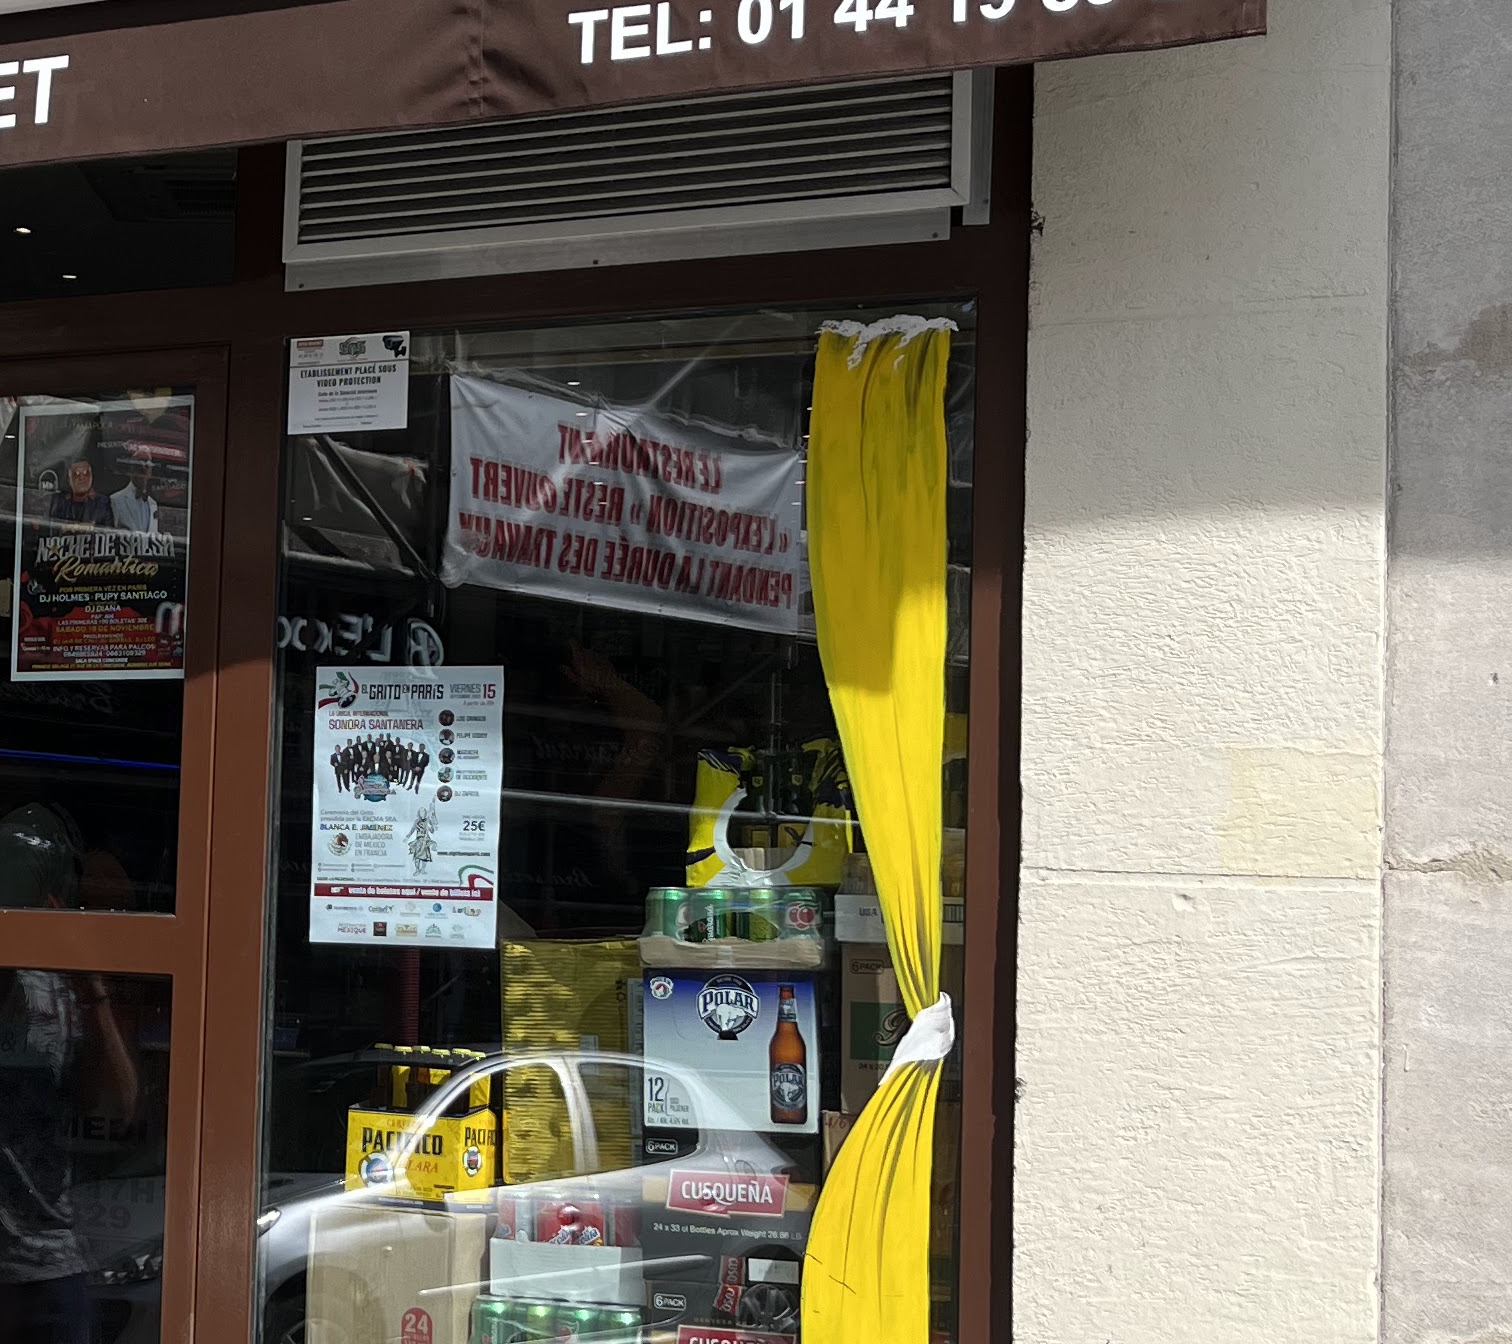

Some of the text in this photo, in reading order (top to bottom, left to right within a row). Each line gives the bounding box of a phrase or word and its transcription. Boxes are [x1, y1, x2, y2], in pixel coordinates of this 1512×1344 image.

[568, 4, 714, 64] TEL:
[378, 364, 397, 373] SOUS
[316, 376, 382, 387] VIDEO PROTECTION
[37, 531, 176, 563] NOCHE DE SALSA
[39, 590, 168, 603] DJ HOLMES PUPY SANTIAGO
[369, 684, 401, 700] GRITO
[482, 683, 496, 699] 15
[328, 719, 424, 730] SONORA SANTANERA
[320, 823, 350, 831] BLANCA
[462, 820, 486, 832] 25€
[701, 989, 756, 1013] POLAR
[773, 1072, 805, 1088] POLAR
[647, 1076, 664, 1102] 12
[681, 1181, 773, 1206] CUSQUEÑA
[653, 1223, 664, 1231] 24
[404, 1313, 429, 1335] 24
